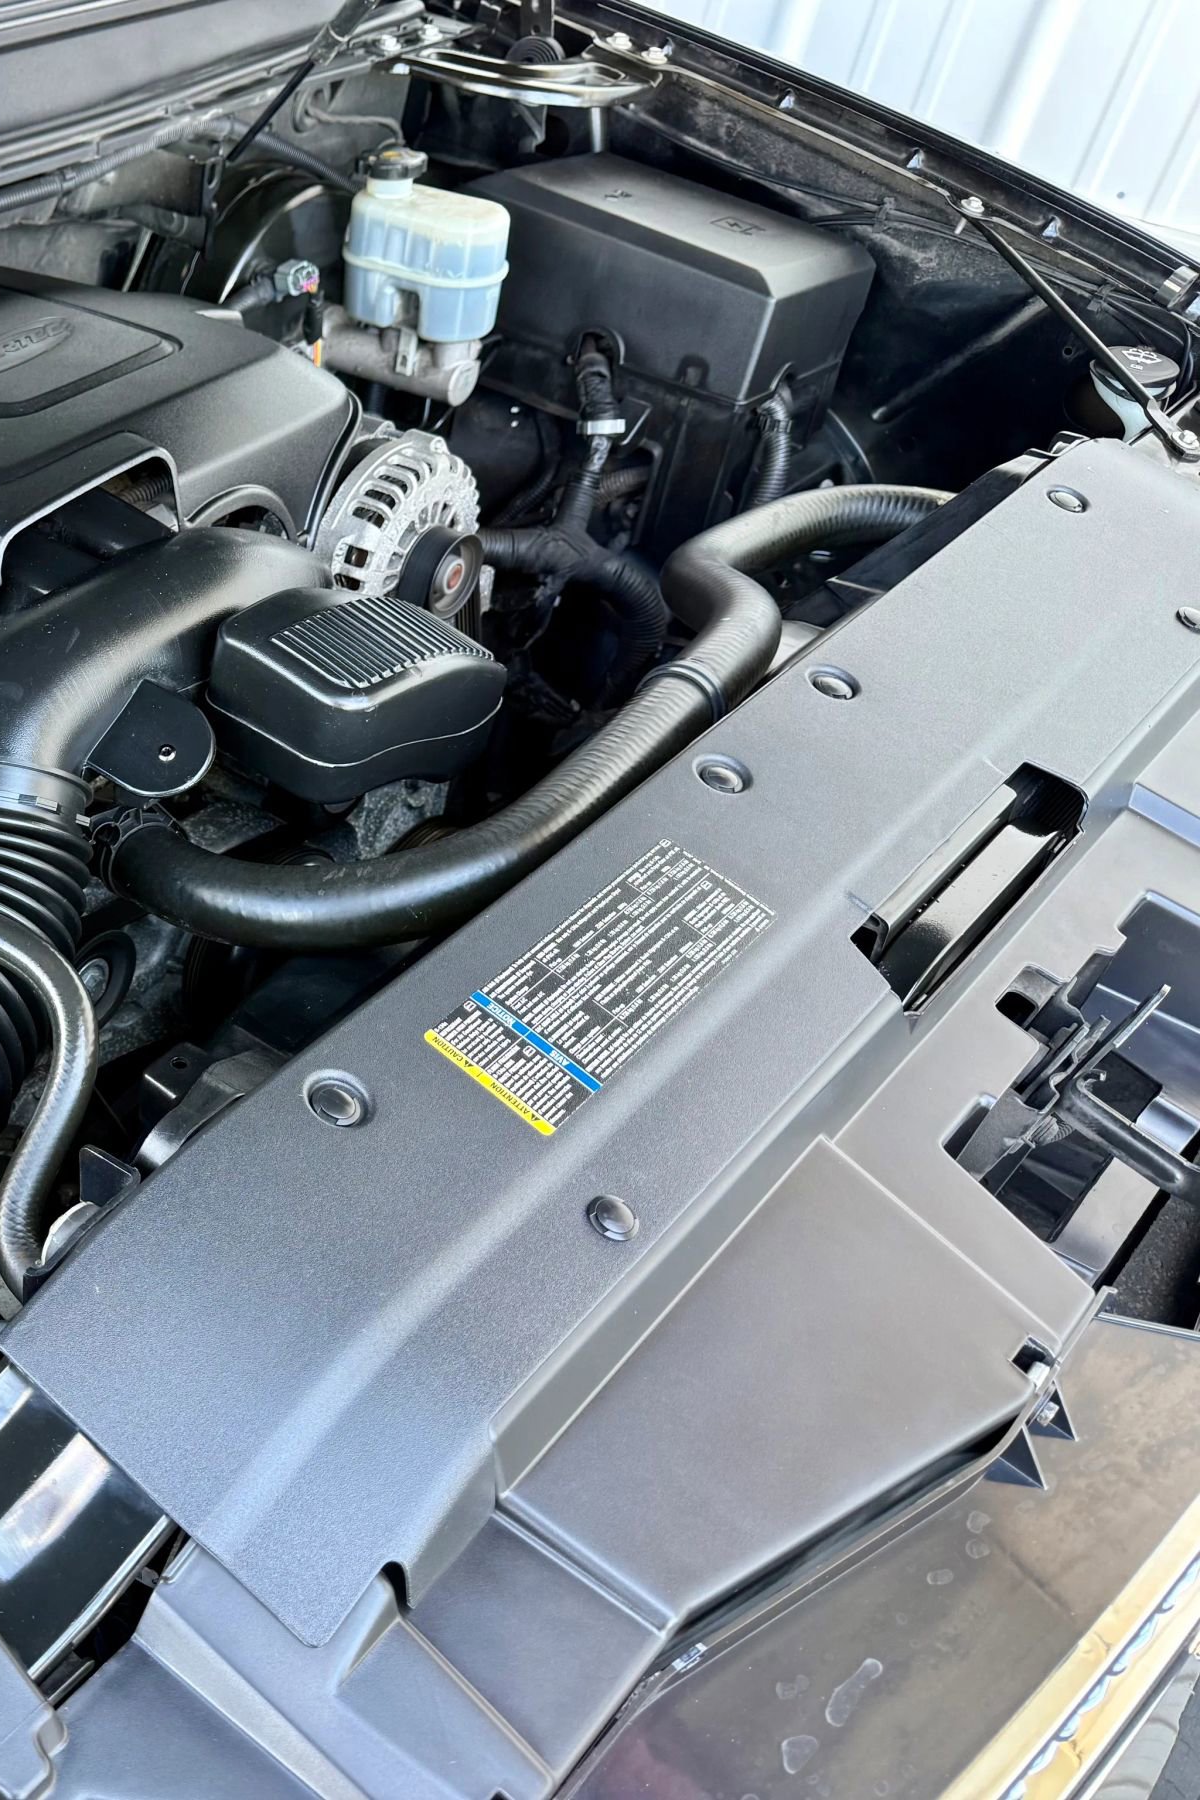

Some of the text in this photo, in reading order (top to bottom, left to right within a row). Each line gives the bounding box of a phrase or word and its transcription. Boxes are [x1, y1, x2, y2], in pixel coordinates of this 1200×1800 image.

[485, 1000, 516, 1027] NOTICE
[432, 1035, 463, 1062] CAUTION
[548, 1048, 570, 1067] AVIS
[489, 1081, 530, 1114] ATTENTION
